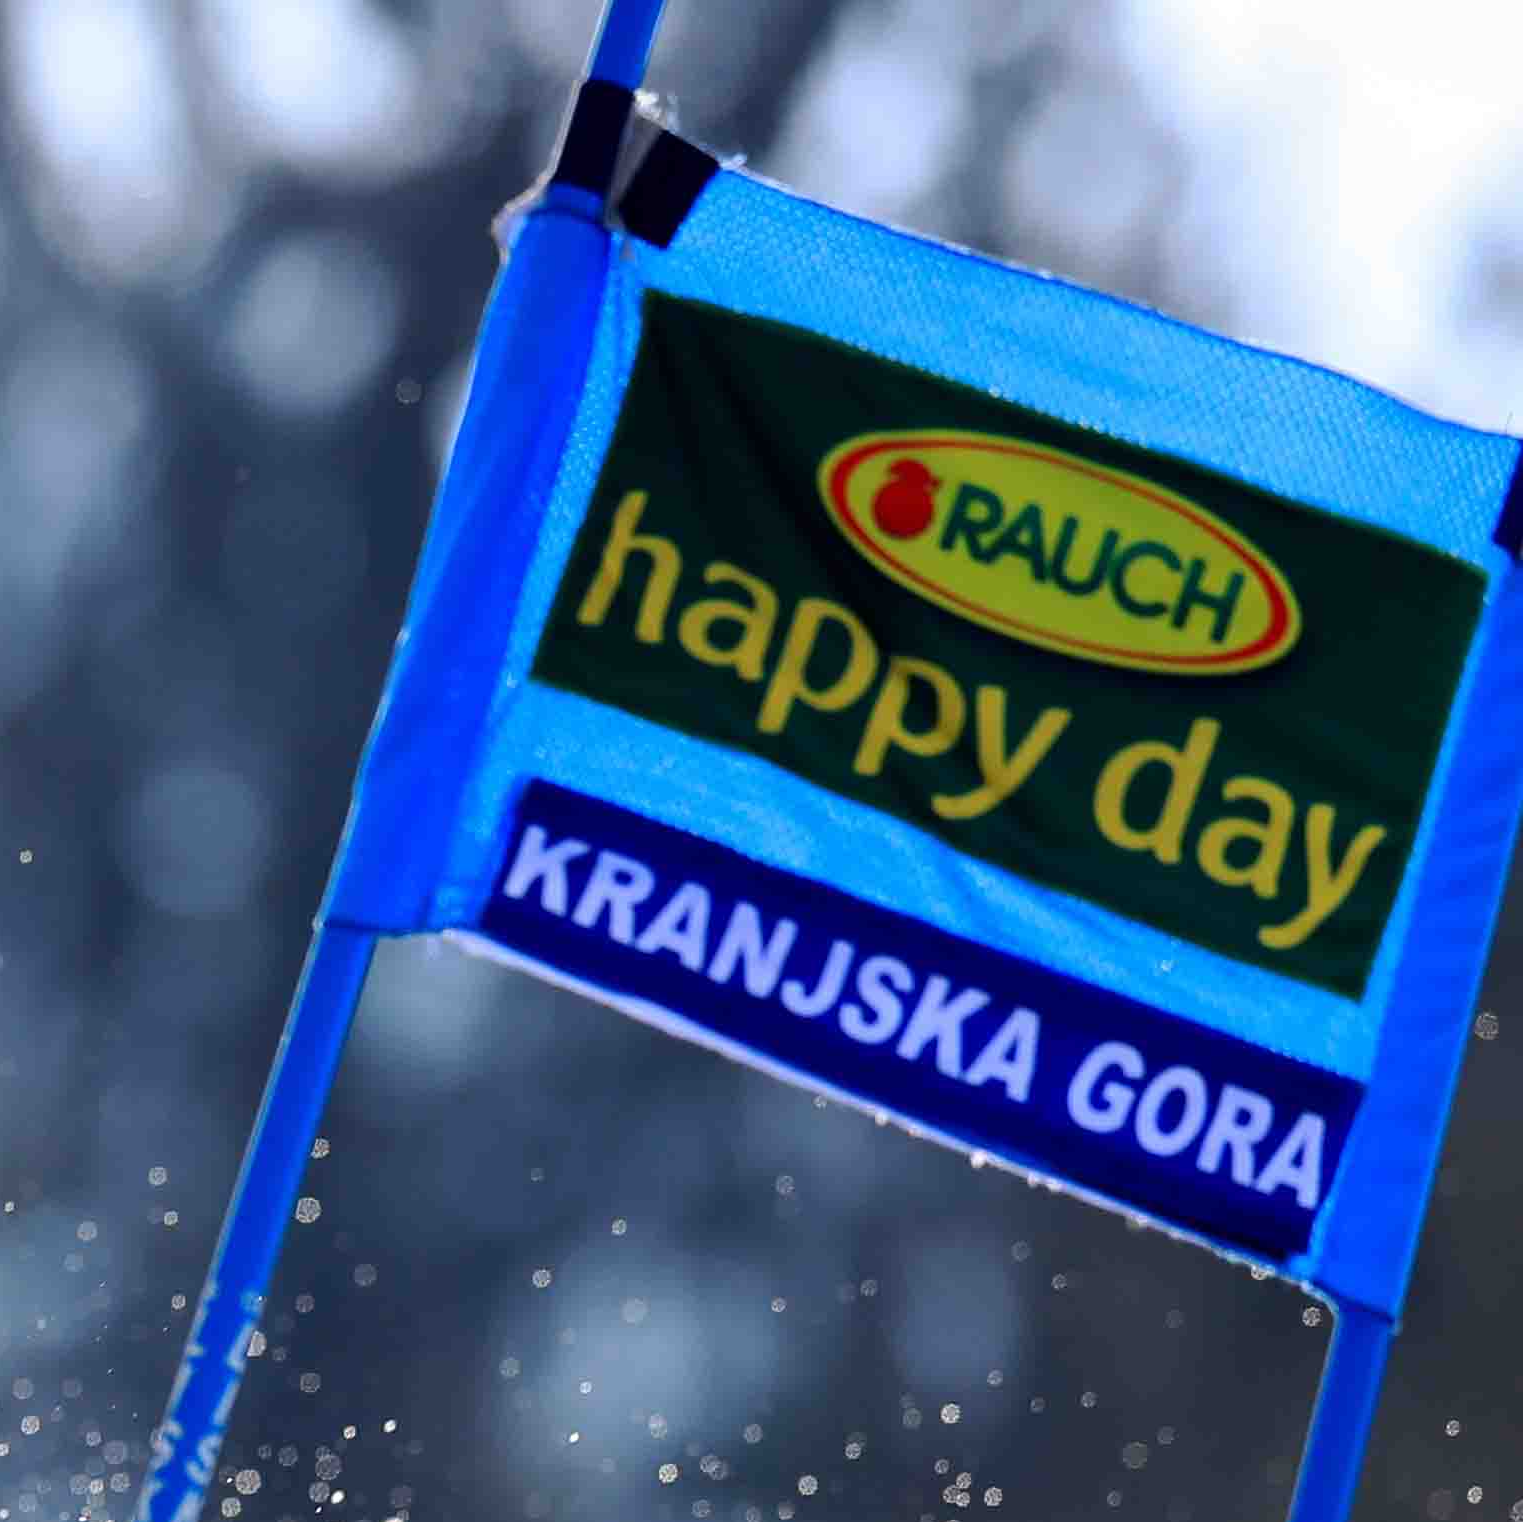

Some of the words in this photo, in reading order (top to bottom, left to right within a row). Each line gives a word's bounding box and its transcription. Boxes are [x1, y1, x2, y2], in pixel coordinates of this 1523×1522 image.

[578, 490, 1070, 819] happy
[1092, 717, 1384, 948] day
[941, 482, 1245, 644] RAUCH
[503, 824, 1036, 1100] KRANJSKA
[1067, 1042, 1324, 1207] GORA
